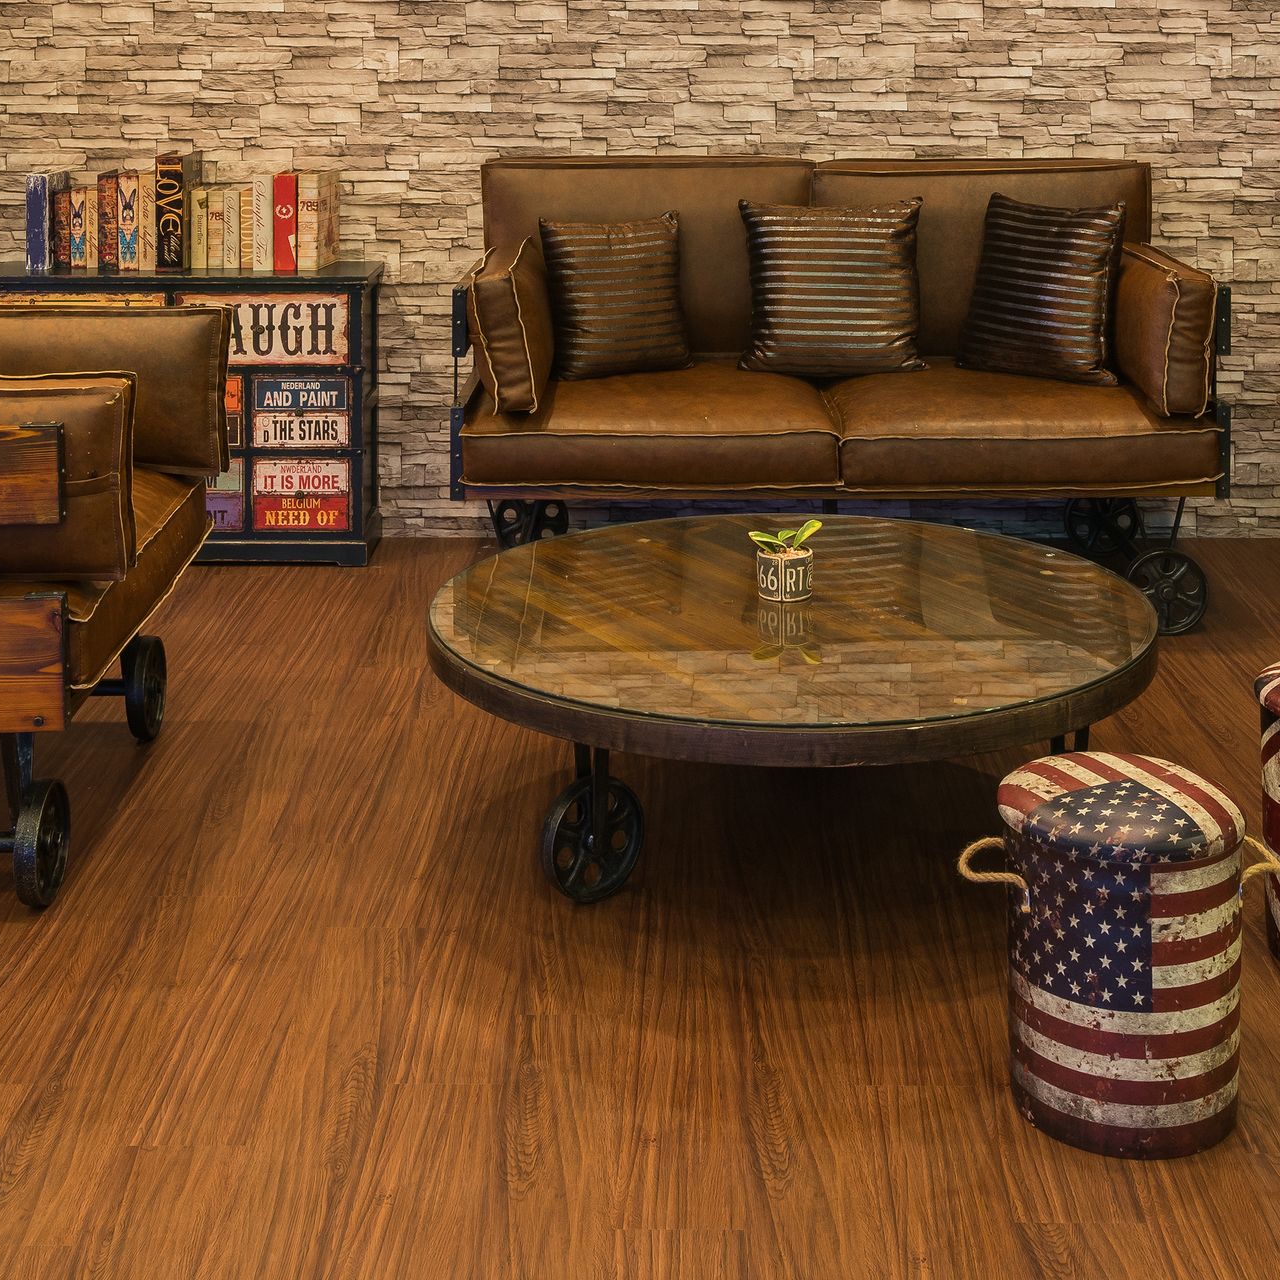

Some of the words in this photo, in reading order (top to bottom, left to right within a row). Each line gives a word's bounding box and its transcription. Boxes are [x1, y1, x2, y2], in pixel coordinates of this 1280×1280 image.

[226, 302, 337, 356] AUGH
[281, 382, 321, 390] NEDERLAND
[263, 392, 292, 407] AND
[299, 391, 338, 407] PAINT
[272, 420, 294, 441] THE
[298, 420, 338, 441] STARS
[280, 465, 322, 474] NWDERLAND
[263, 475, 277, 489] IT
[281, 475, 294, 489] IS
[298, 475, 339, 490] MORE
[281, 498, 321, 509] BELGIUM
[264, 510, 310, 526] NEED
[316, 510, 338, 526] OF
[760, 565, 777, 591] 66
[786, 566, 805, 592] RT
